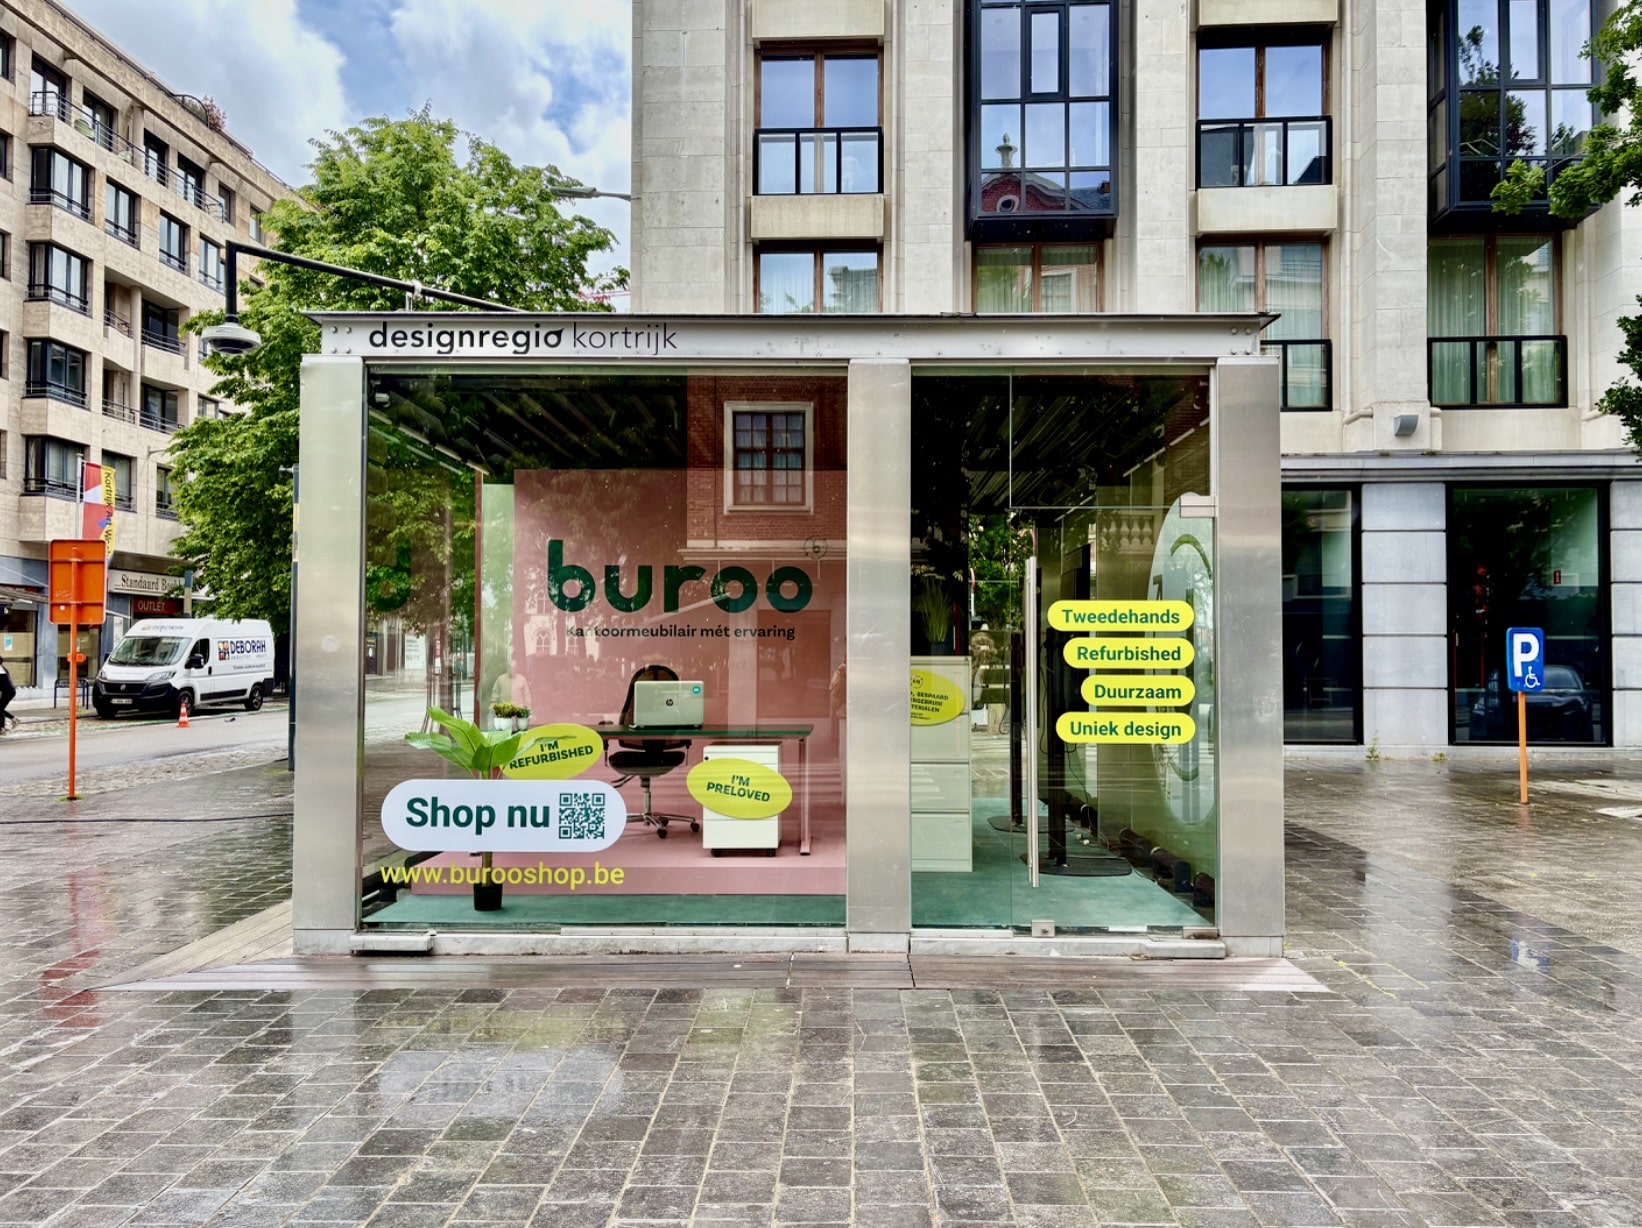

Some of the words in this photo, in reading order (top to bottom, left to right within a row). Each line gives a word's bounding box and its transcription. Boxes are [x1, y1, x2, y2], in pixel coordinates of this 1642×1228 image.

[369, 321, 564, 355] designregio
[573, 321, 678, 356] kortrijk
[104, 472, 113, 508] Kortrijk
[121, 573, 159, 590] Standaard
[547, 539, 813, 613] buroo
[138, 600, 166, 611] OUTLET
[1062, 609, 1180, 624] Tweedehands
[700, 624, 730, 638] mét
[734, 624, 795, 641] ervaring
[230, 639, 266, 654] DEBORAH
[1077, 645, 1181, 661] Refurbished
[1513, 633, 1539, 677] P
[917, 692, 949, 701] BESPAARD
[1094, 684, 1182, 699] Duurzaam
[1070, 721, 1119, 736] Uniek
[1124, 721, 1182, 740] design
[540, 740, 559, 752] I'M
[509, 745, 594, 769] REFURBISHED
[731, 774, 750, 787] I'M
[706, 781, 771, 802] PRELOVED
[405, 796, 496, 836] Shop
[507, 805, 550, 828] nu
[380, 861, 625, 891] www.burooshop.be
